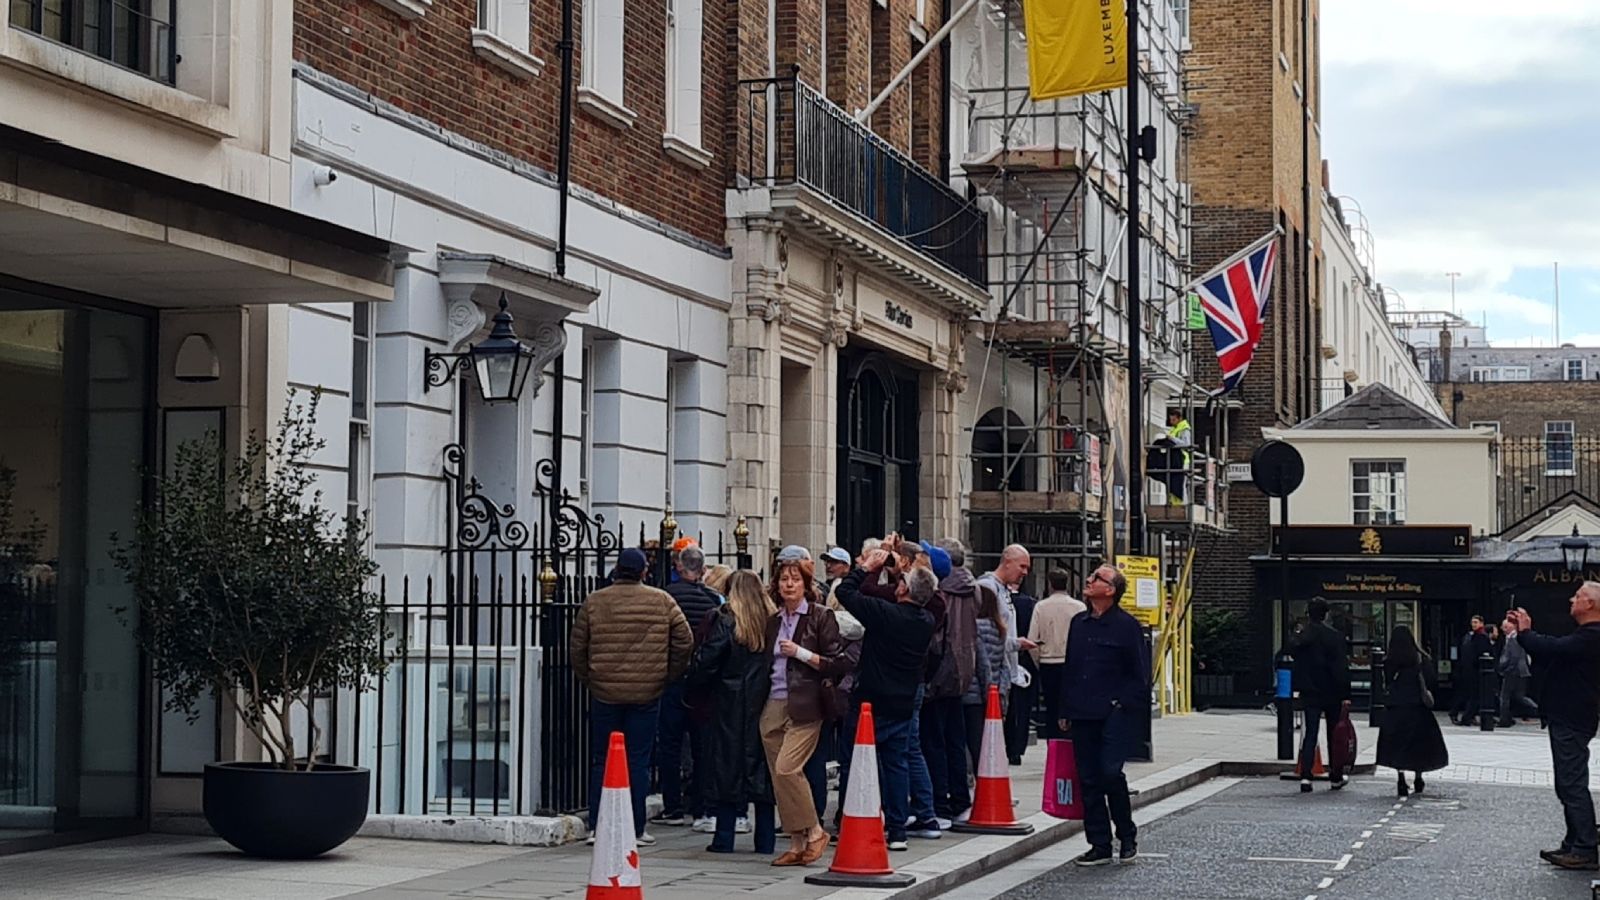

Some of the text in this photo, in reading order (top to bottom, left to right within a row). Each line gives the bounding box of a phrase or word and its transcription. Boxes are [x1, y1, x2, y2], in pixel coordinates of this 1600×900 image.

[1454, 535, 1465, 546] 12
[1363, 574, 1397, 583] Jewellery
[1360, 583, 1387, 593] Buying
[1396, 583, 1422, 593] Selling
